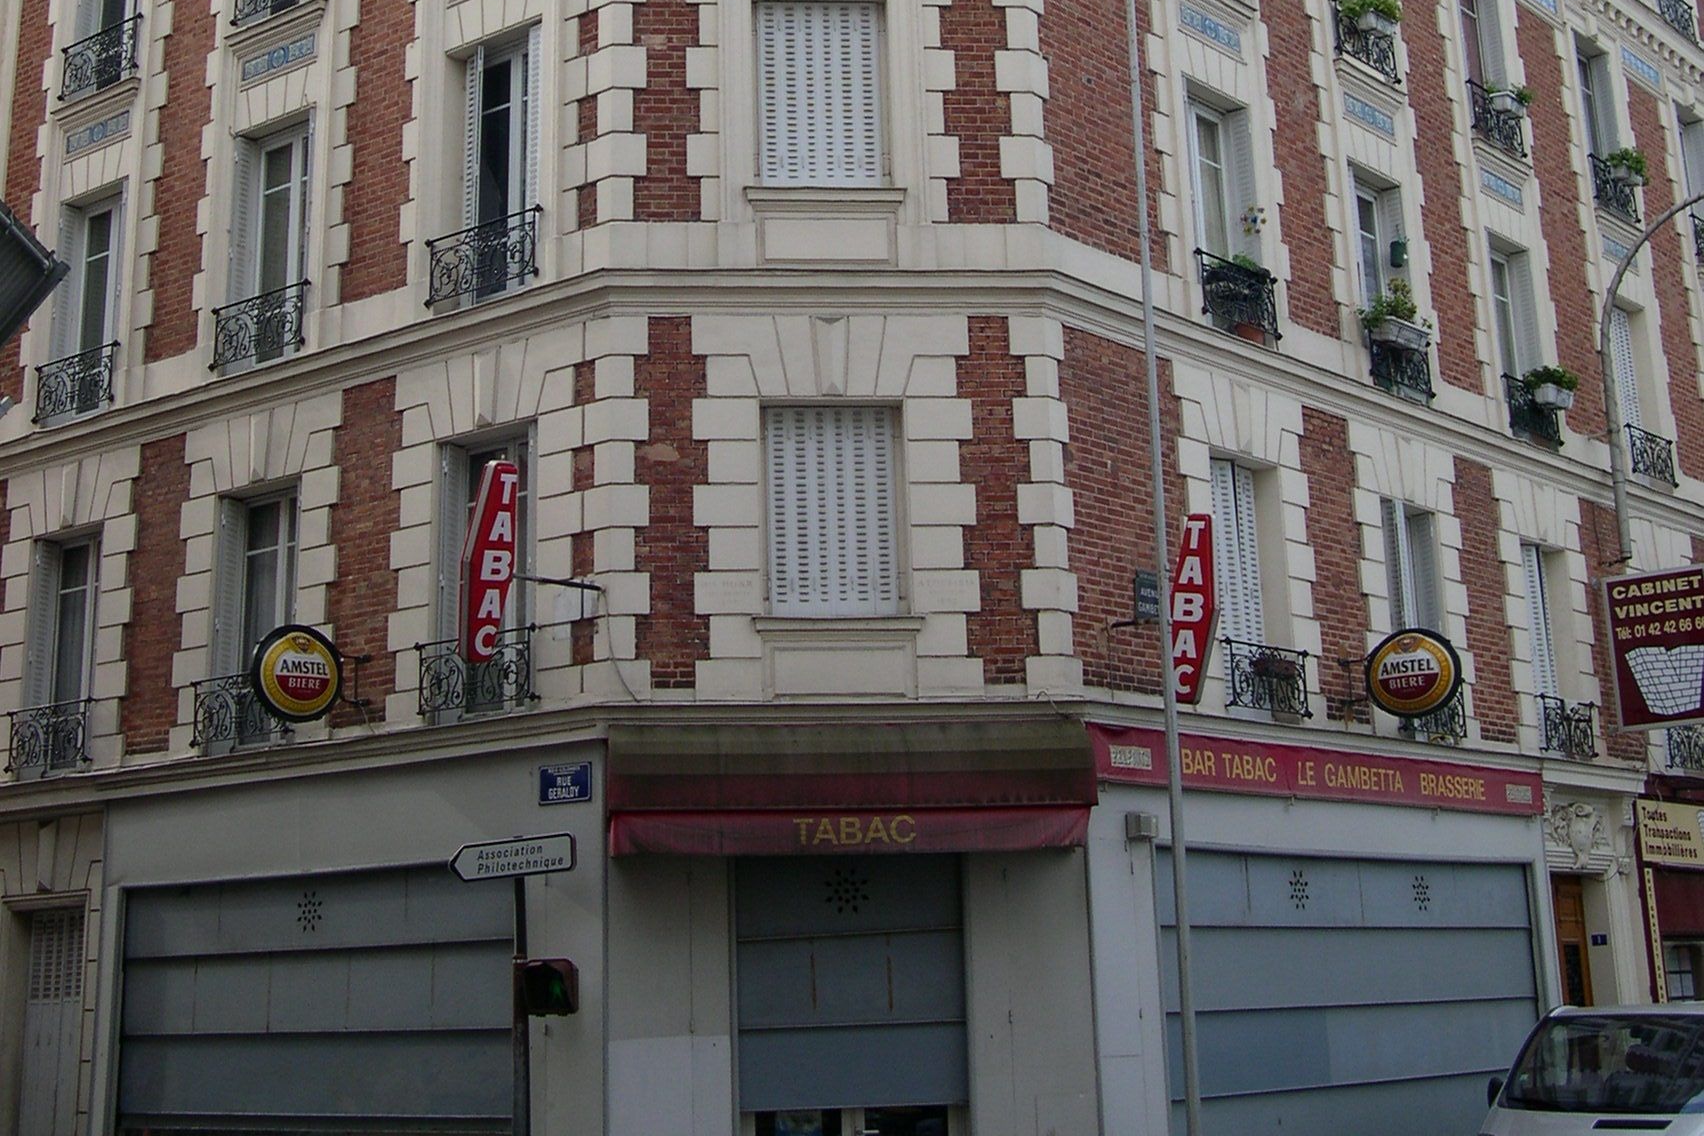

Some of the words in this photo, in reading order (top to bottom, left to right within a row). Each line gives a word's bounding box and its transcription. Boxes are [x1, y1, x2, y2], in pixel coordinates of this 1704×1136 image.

[475, 473, 517, 656] TABAC
[1612, 575, 1702, 599] CABINET
[1173, 520, 1205, 694] TABAC
[1615, 595, 1704, 619] VINCENT
[1634, 625, 1646, 638] 01
[1648, 622, 1661, 636] 42
[1663, 620, 1677, 633] 42
[1679, 617, 1693, 632] 66
[280, 659, 328, 676] AMSTEL
[1381, 658, 1434, 677] AMSTEL
[288, 676, 321, 690] BIERE
[1389, 675, 1425, 689] BIERE
[556, 775, 571, 786] RUE
[1181, 748, 1216, 776] BAR
[1222, 753, 1277, 783] TABAC
[1297, 760, 1316, 786] LE
[1324, 763, 1404, 793] GAMBETTA
[1420, 772, 1486, 800] BRASSERIE
[1641, 806, 1667, 822] Toutes
[792, 814, 916, 845] TABAC
[1643, 823, 1691, 841] Transactions
[477, 844, 543, 861] Association
[477, 856, 564, 875] Philotechnique
